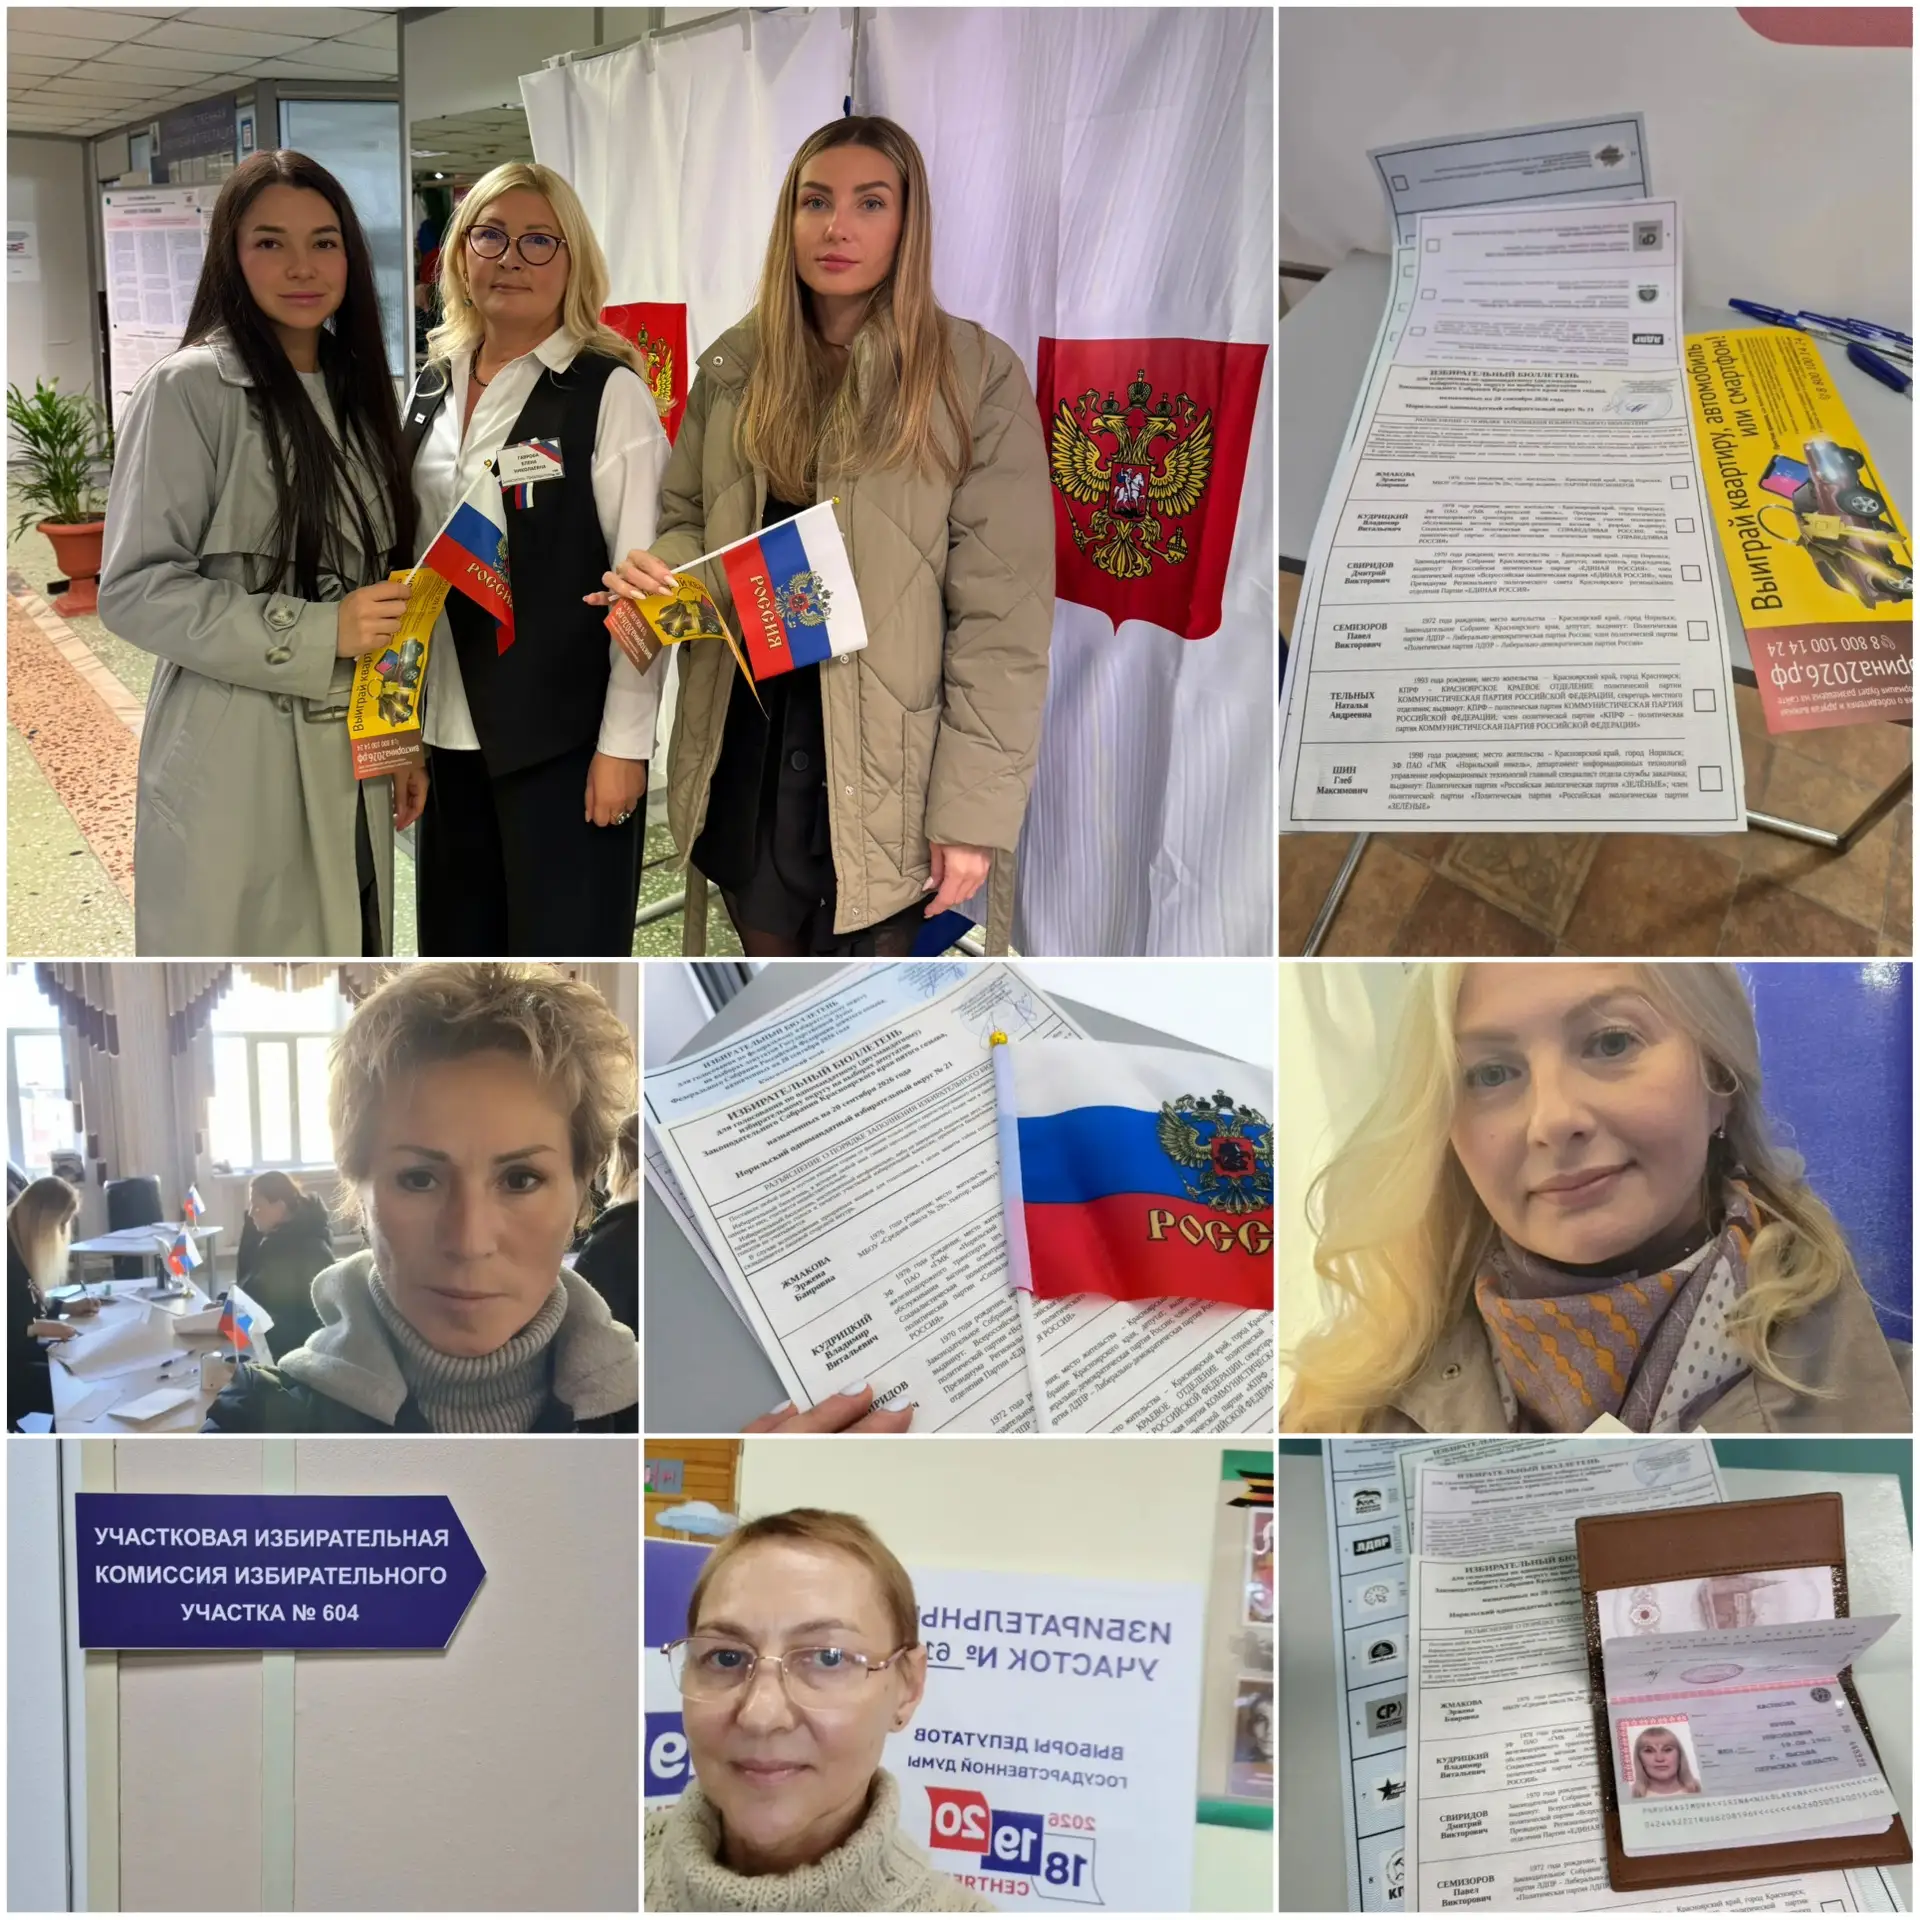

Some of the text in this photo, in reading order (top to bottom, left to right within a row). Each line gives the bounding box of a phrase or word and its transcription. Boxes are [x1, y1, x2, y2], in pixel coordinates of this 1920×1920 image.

[1704, 336, 1759, 437] или смартфон!
[1687, 344, 1783, 610] Выиграй квартиру, автомобиль
[1346, 561, 1393, 569] СВИРИДОВ
[1350, 569, 1386, 577] Дмитрий
[465, 562, 512, 608] РОССИ
[1344, 577, 1390, 585] Викторович
[750, 575, 782, 648] РОССИЯ
[1332, 622, 1387, 631] СЕМИЗОРОВ
[1334, 641, 1381, 649] Викторович
[1767, 636, 1880, 657] 8 800 100 14 24
[353, 652, 372, 732] Выиграй кварт
[1331, 691, 1374, 700] ТЕЛЬНЫХ
[1441, 684, 1497, 692] КРАСНОЯРСКОЕ
[1507, 683, 1539, 691] КРАЕВОЕ
[1549, 682, 1593, 690] ОТДЕЛЕНИЕ
[1334, 701, 1368, 709] Наталья
[1329, 711, 1372, 720] Андреевна
[1332, 766, 1356, 774] ШИН
[1333, 775, 1352, 784] Глеб
[1316, 786, 1368, 794] Максимович
[727, 1029, 902, 1120] ИЗБИРАТЕЛЬНЫЙ БЮЛЛЕТЕНЬ
[766, 1068, 911, 1145] назначенных на 20 сентября 2026 года
[735, 1060, 952, 1178] Норильский одномандатный избирательный округ № 21
[869, 1218, 906, 1240] 1976 года
[1146, 1208, 1273, 1256] РОСС
[781, 1256, 831, 1289] ЖМАКОВА
[793, 1270, 826, 1291] Эржена
[794, 1274, 836, 1301] Баировна
[889, 1267, 946, 1306] железнодорожного
[893, 1283, 939, 1314] обслуживания
[898, 1283, 957, 1322] Социалистическая
[811, 1314, 872, 1356] КУДРИЦКИЙ
[908, 1315, 944, 1340] РОССИЯ»
[824, 1328, 869, 1359] Владимир
[825, 1334, 878, 1370] Витальевич
[95, 1527, 449, 1547] УЧАСТКОВАЯ ИЗБИРАТЕЛЬНАЯ
[1356, 1536, 1388, 1550] ЛДПР
[96, 1566, 447, 1585] КОМИССИЯ ИЗБИРАТЕЛЬНОГО
[181, 1604, 359, 1621] УЧАСТКА № 604
[1440, 1699, 1482, 1708] ЖМАКОВА
[1436, 1752, 1488, 1764] КУДРИЦКИЙ
[1443, 1762, 1482, 1770] Владимир
[1440, 1769, 1485, 1778] Витальевич
[1439, 1810, 1488, 1822] СВИРИДОВ
[1446, 1819, 1482, 1830] Дмитрий
[1440, 1828, 1488, 1839] Викторович
[1436, 1875, 1494, 1888] СЕМИЗОРОВ
[1453, 1887, 1479, 1896] Павел
[1441, 1895, 1491, 1906] Викторович
